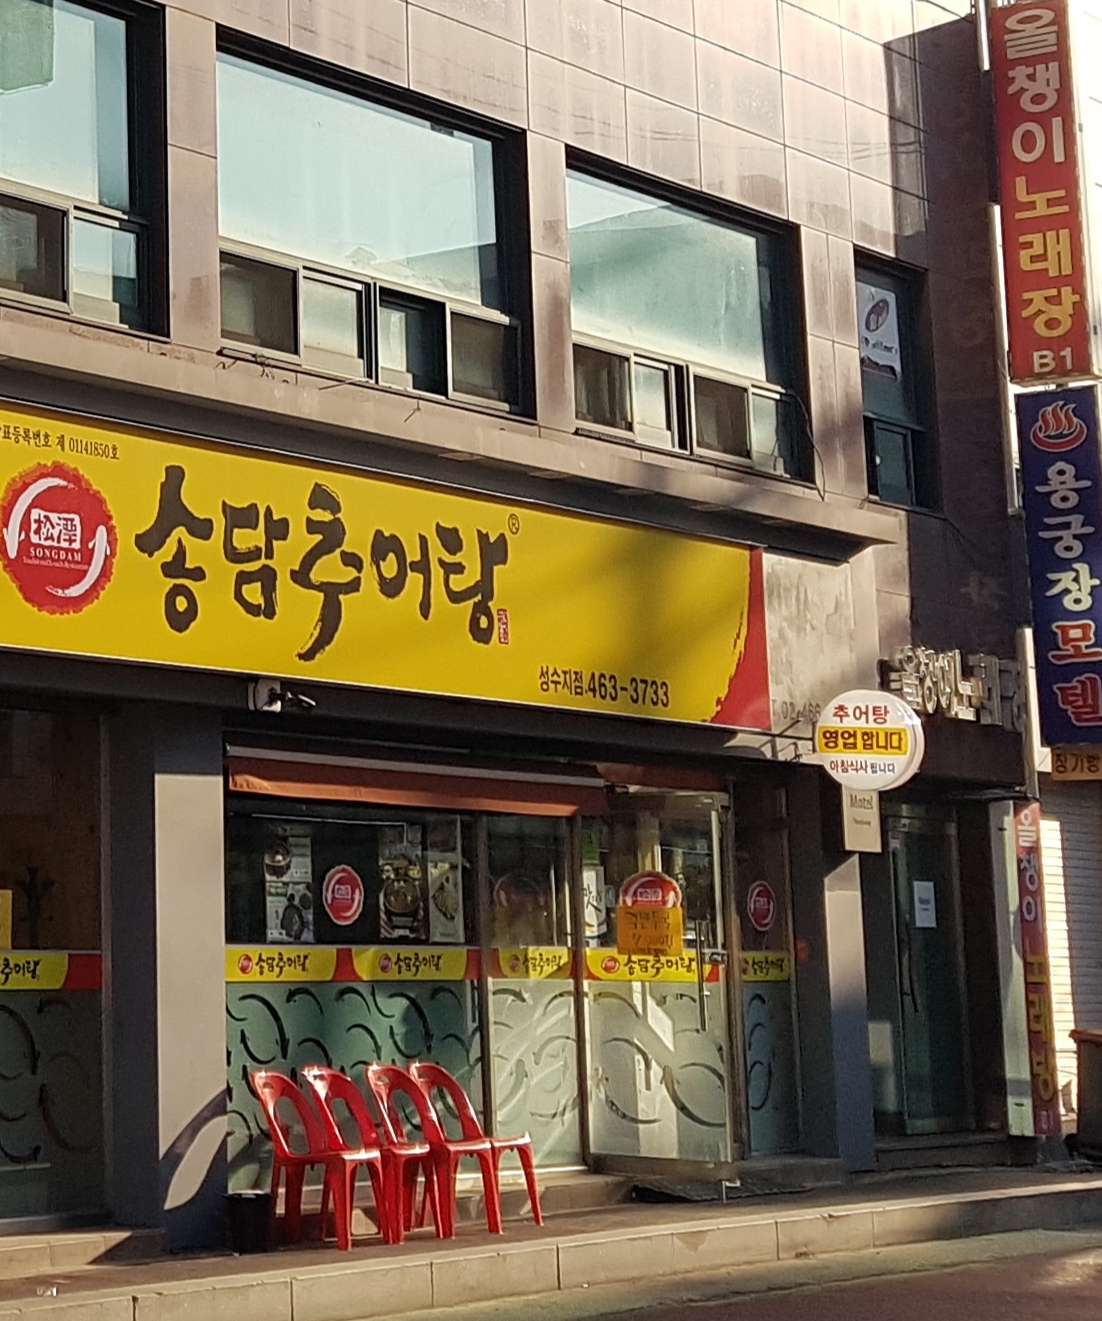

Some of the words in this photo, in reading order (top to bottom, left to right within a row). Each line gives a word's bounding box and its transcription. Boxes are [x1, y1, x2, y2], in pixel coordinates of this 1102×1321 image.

[1003, 7, 1065, 163] 올챙이
[1015, 176, 1082, 339] 노래장
[1033, 349, 1074, 374] B1
[55, 434, 65, 452] 제
[1035, 460, 1102, 613] 용궁장
[29, 546, 82, 562] SONGDAM
[135, 465, 509, 662] 송담추어탕
[1047, 620, 1102, 727] 모텔
[832, 704, 890, 725] 추어탕
[822, 729, 858, 751] 영업
[861, 730, 904, 752] 합니다
[255, 952, 309, 977] 송담추어탕
